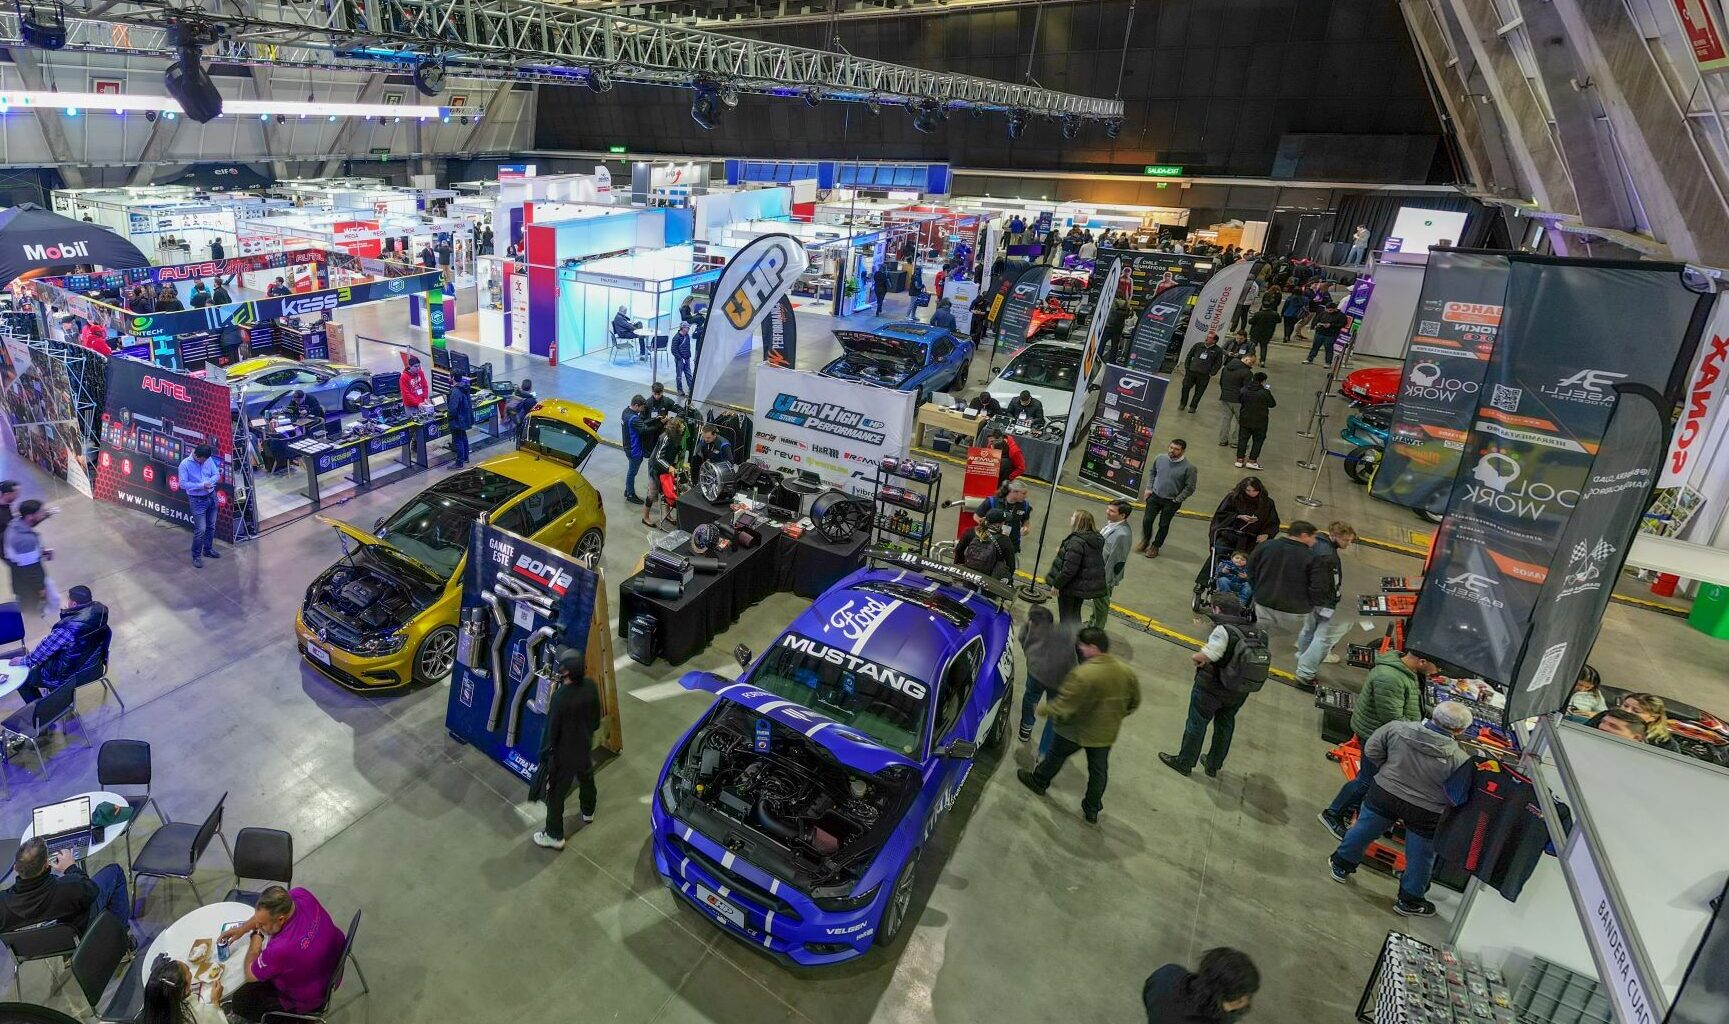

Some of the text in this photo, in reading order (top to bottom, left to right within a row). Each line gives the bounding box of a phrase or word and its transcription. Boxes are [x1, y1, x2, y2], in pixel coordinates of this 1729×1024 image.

[23, 241, 89, 261] Mobil
[159, 262, 224, 280] AUTEL
[721, 243, 790, 331] UHP
[1205, 298, 1218, 320] CHILE
[142, 375, 191, 402] AUTEL
[773, 393, 861, 427] ULTRA HIGH
[804, 417, 884, 445] PERFORMANCE
[774, 449, 881, 467] revo REMU
[492, 551, 509, 567] ESTE
[921, 560, 983, 582] WHITELINE
[830, 596, 889, 640] Ford
[782, 634, 927, 701] MUSTANG
[826, 921, 868, 935] VELGEN
[1597, 899, 1630, 982] BANDERA
